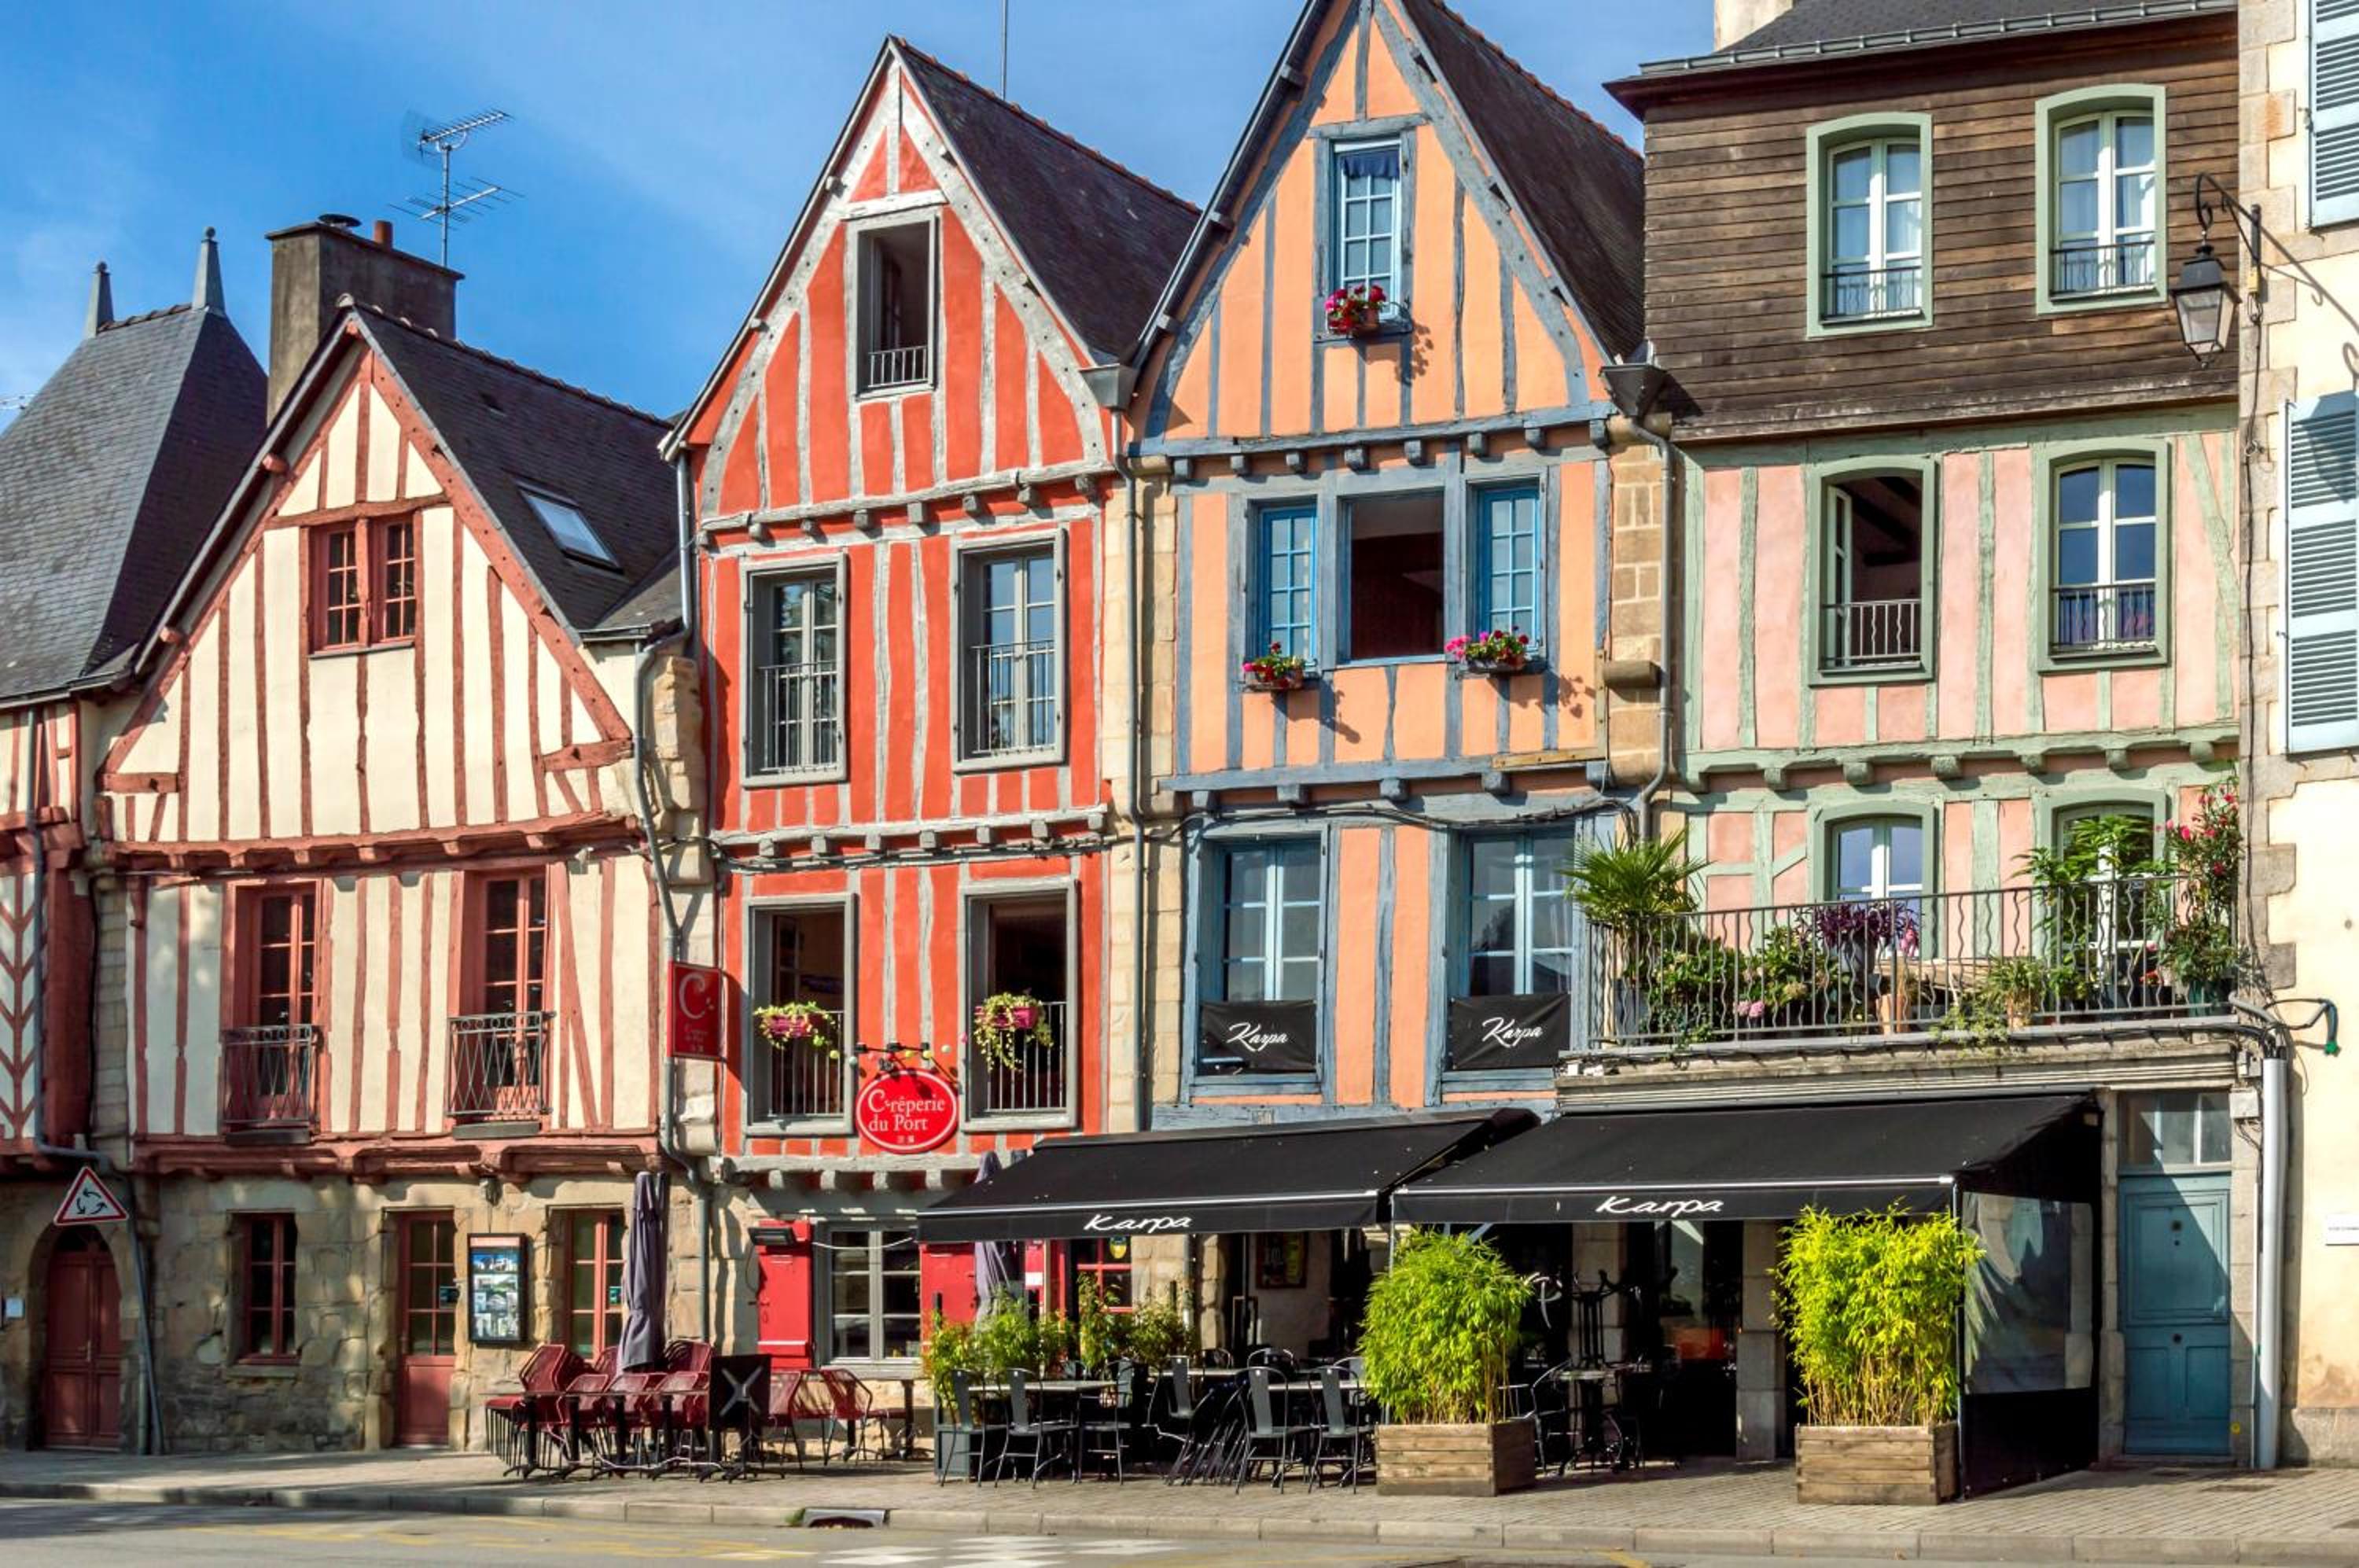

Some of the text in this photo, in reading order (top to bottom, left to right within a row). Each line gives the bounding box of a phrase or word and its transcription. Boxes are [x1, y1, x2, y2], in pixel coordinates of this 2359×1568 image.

[1227, 1022, 1289, 1052] Karpa
[1481, 1017, 1544, 1048] Karpa
[867, 1088, 945, 1117] Crêperie
[868, 1113, 928, 1132] du Port
[1595, 1195, 1724, 1218] Karpa
[1083, 1213, 1193, 1234] Karpa
